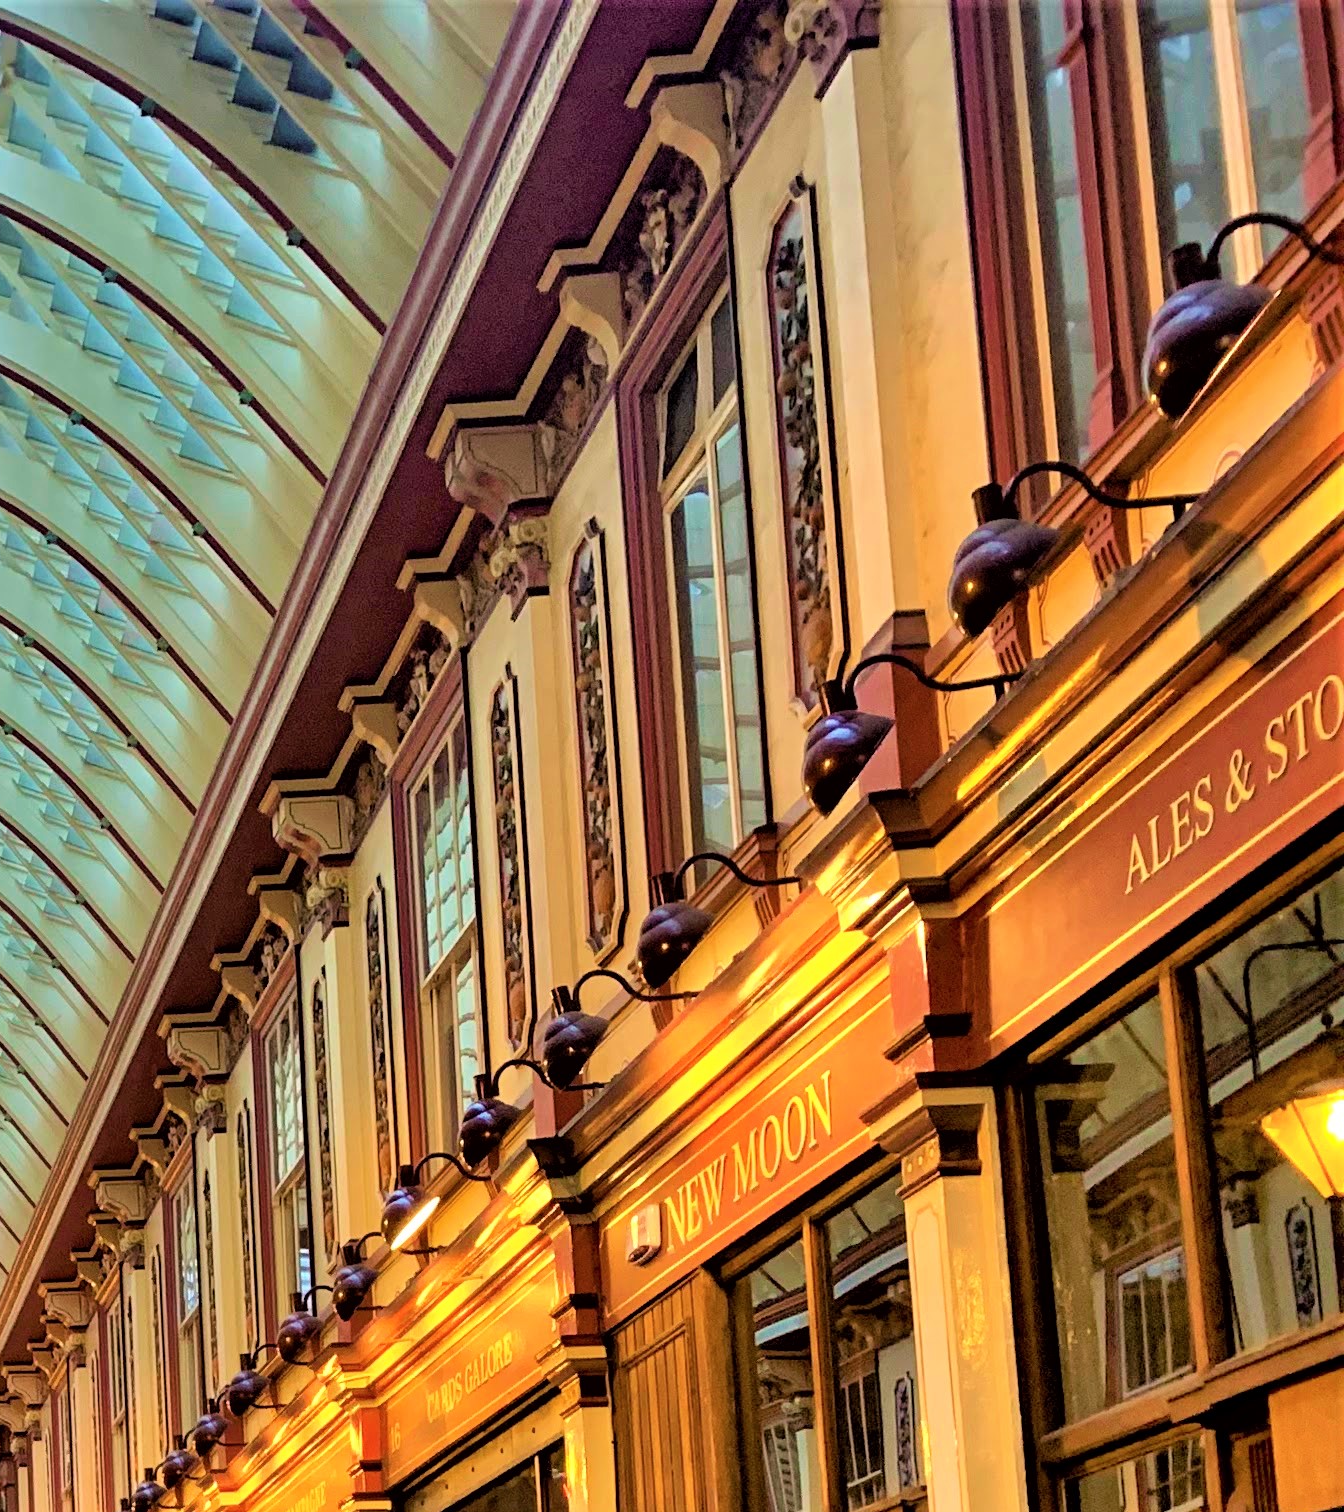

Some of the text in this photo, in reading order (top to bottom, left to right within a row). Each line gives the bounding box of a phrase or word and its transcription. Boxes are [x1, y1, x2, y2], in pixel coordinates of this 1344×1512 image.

[1124, 674, 1344, 895] ALES & STO
[664, 1070, 832, 1253] NEW MOON
[391, 1422, 402, 1452] 16
[426, 1331, 513, 1424] CARDS GALORE
